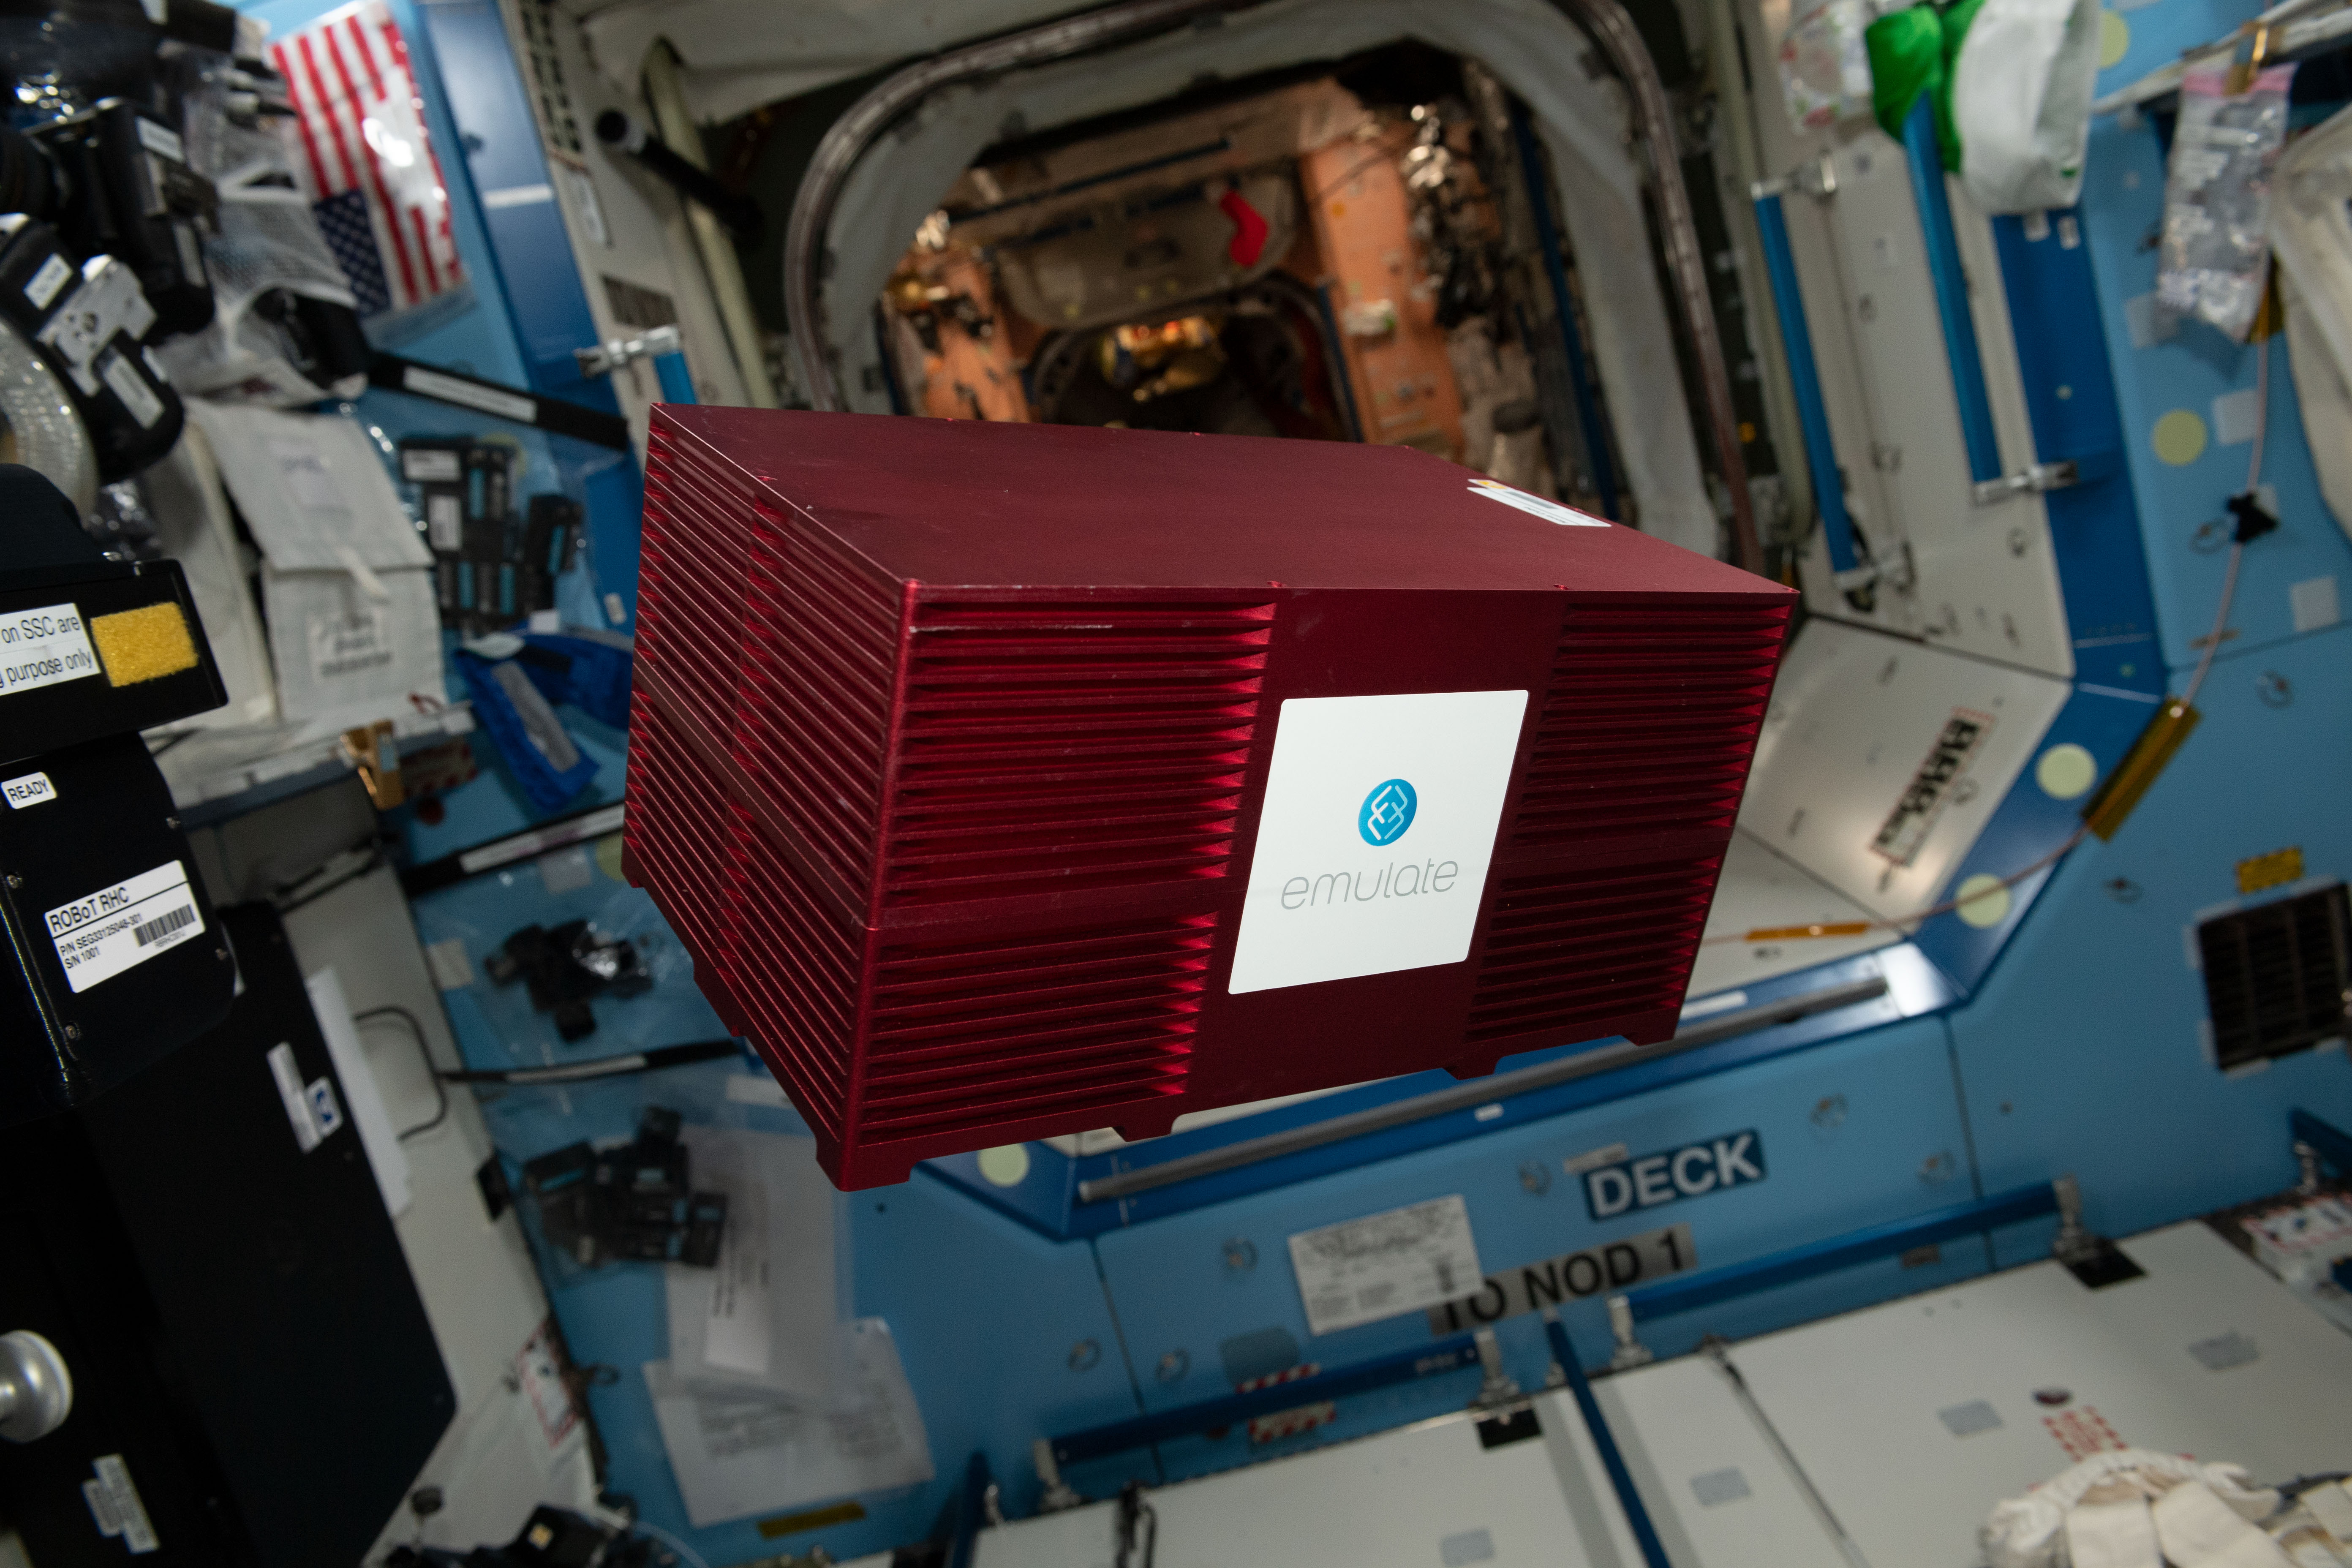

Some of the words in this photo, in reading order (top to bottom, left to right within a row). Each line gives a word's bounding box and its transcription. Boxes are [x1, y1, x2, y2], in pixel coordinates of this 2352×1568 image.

[1, 627, 21, 643] on
[20, 616, 55, 640] SSC
[57, 616, 81, 633] are
[5, 658, 63, 686] purpose
[65, 648, 92, 669] only
[7, 779, 49, 802] READY
[1280, 858, 1458, 910] emulate
[48, 899, 98, 933] ROBoT
[98, 887, 130, 912] RHC
[59, 942, 76, 956] P/N
[64, 954, 81, 969] S/N
[81, 946, 101, 961] 1001
[1587, 1133, 1762, 1217] DECK
[1522, 1242, 1641, 1311] NOD
[1659, 1227, 1683, 1271] 1
